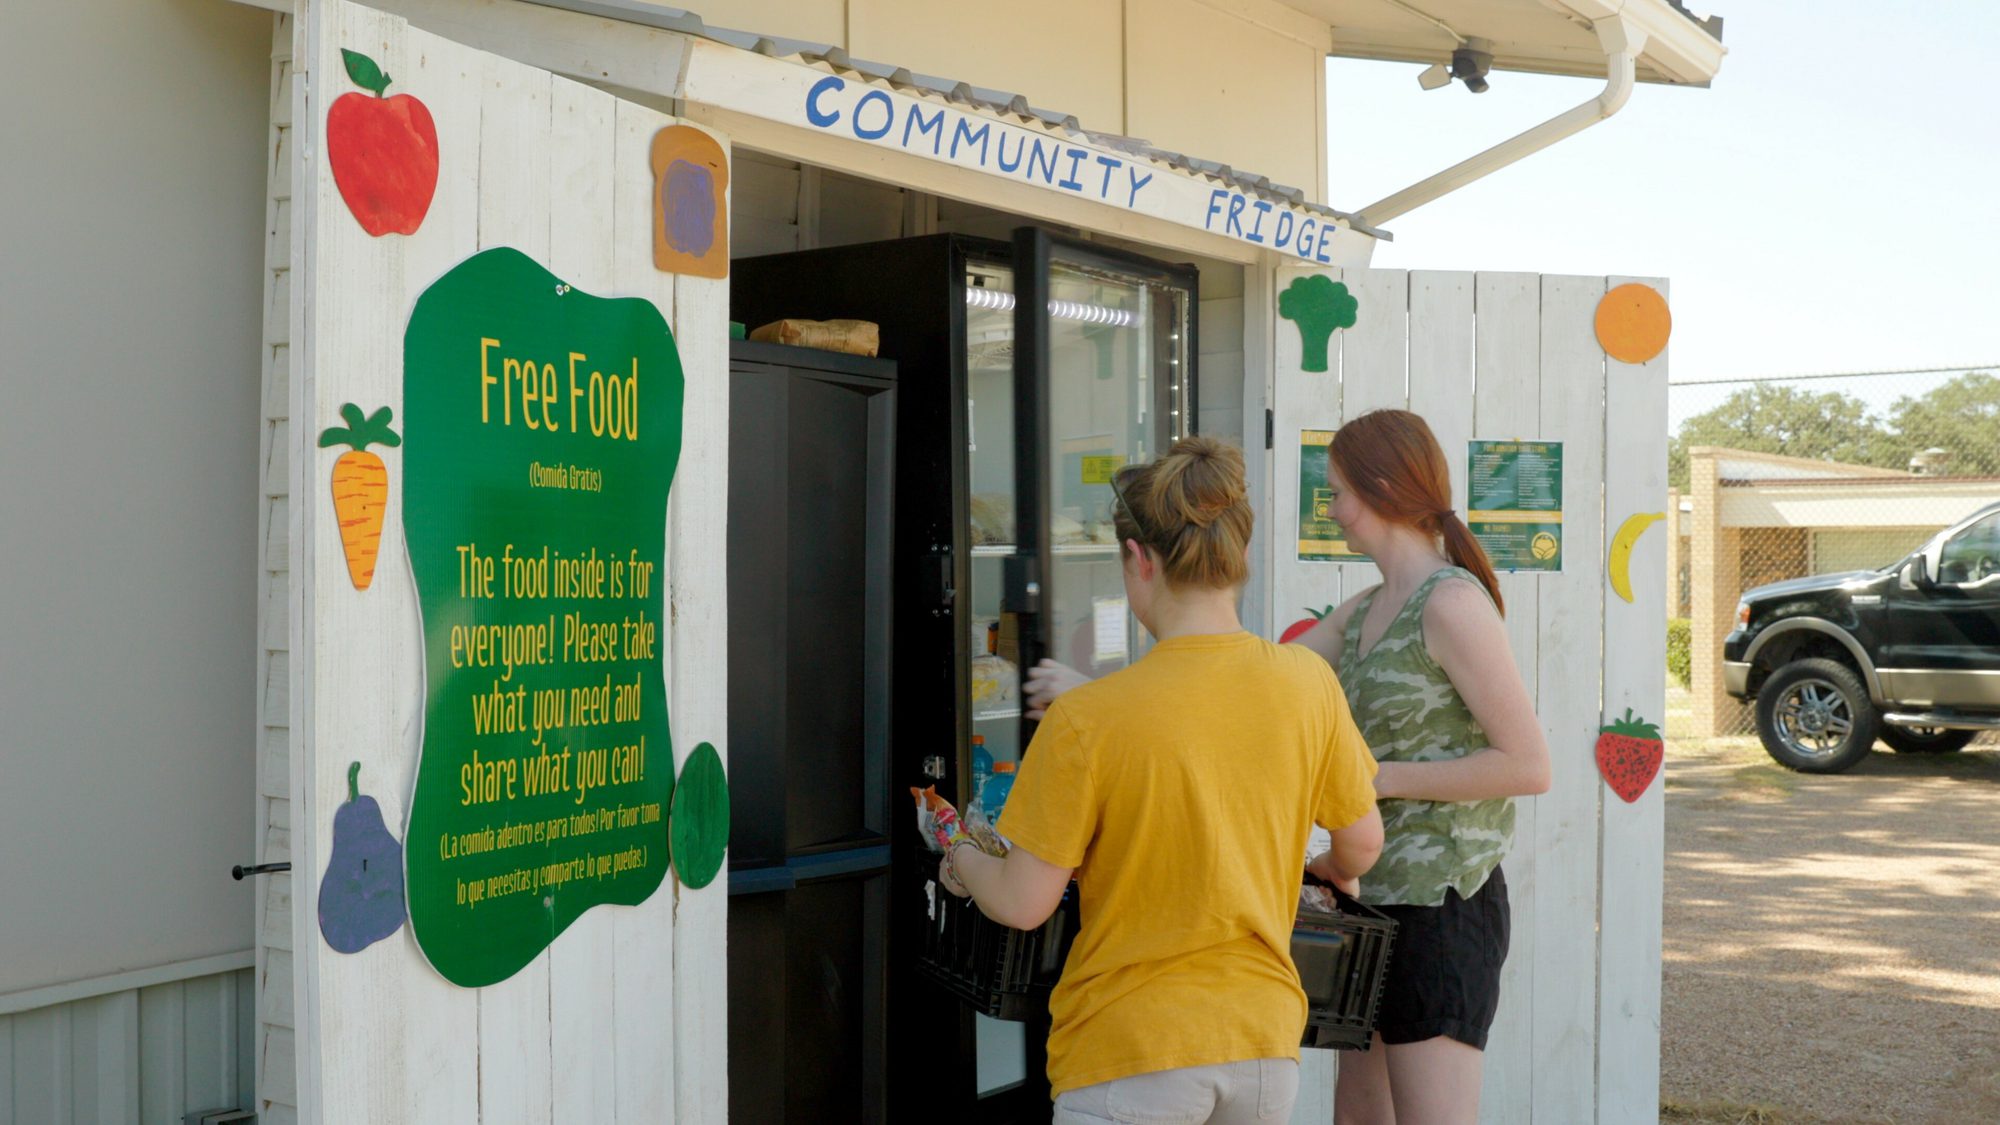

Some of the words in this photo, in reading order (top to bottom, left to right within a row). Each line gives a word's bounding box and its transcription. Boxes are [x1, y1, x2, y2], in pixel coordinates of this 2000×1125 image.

[805, 76, 1152, 208] COMMUNITY
[1205, 189, 1335, 263] FRIDGE
[480, 337, 559, 432] Free
[569, 351, 638, 441] Food
[529, 461, 567, 490] (Comida
[569, 463, 602, 493] Gratis)
[456, 543, 494, 600] The
[502, 543, 548, 599] food
[554, 547, 605, 599] inside
[610, 553, 624, 598] is
[628, 548, 653, 598] for
[451, 614, 554, 682] everyone!
[564, 611, 618, 663] Please
[623, 610, 655, 660] take
[472, 679, 527, 735] what
[532, 688, 565, 746] you
[570, 673, 610, 727] need
[615, 671, 641, 723] and
[461, 750, 517, 806] share
[523, 742, 571, 797] what
[575, 748, 607, 805] you
[611, 735, 645, 785] can!
[440, 832, 458, 861] (La
[460, 824, 495, 856] comida
[497, 821, 533, 849] adentro
[534, 821, 545, 843] es
[546, 818, 568, 848] para
[570, 808, 600, 837] todos!
[600, 807, 616, 832] Por
[617, 803, 640, 828] favor
[641, 802, 660, 825] toma
[457, 877, 467, 905] lo
[468, 879, 485, 910] que
[487, 868, 531, 899] necesitas
[533, 868, 540, 896] y
[540, 857, 585, 891] comparte
[586, 852, 596, 878] lo
[597, 854, 612, 882] que
[613, 845, 648, 880] puedas.)
